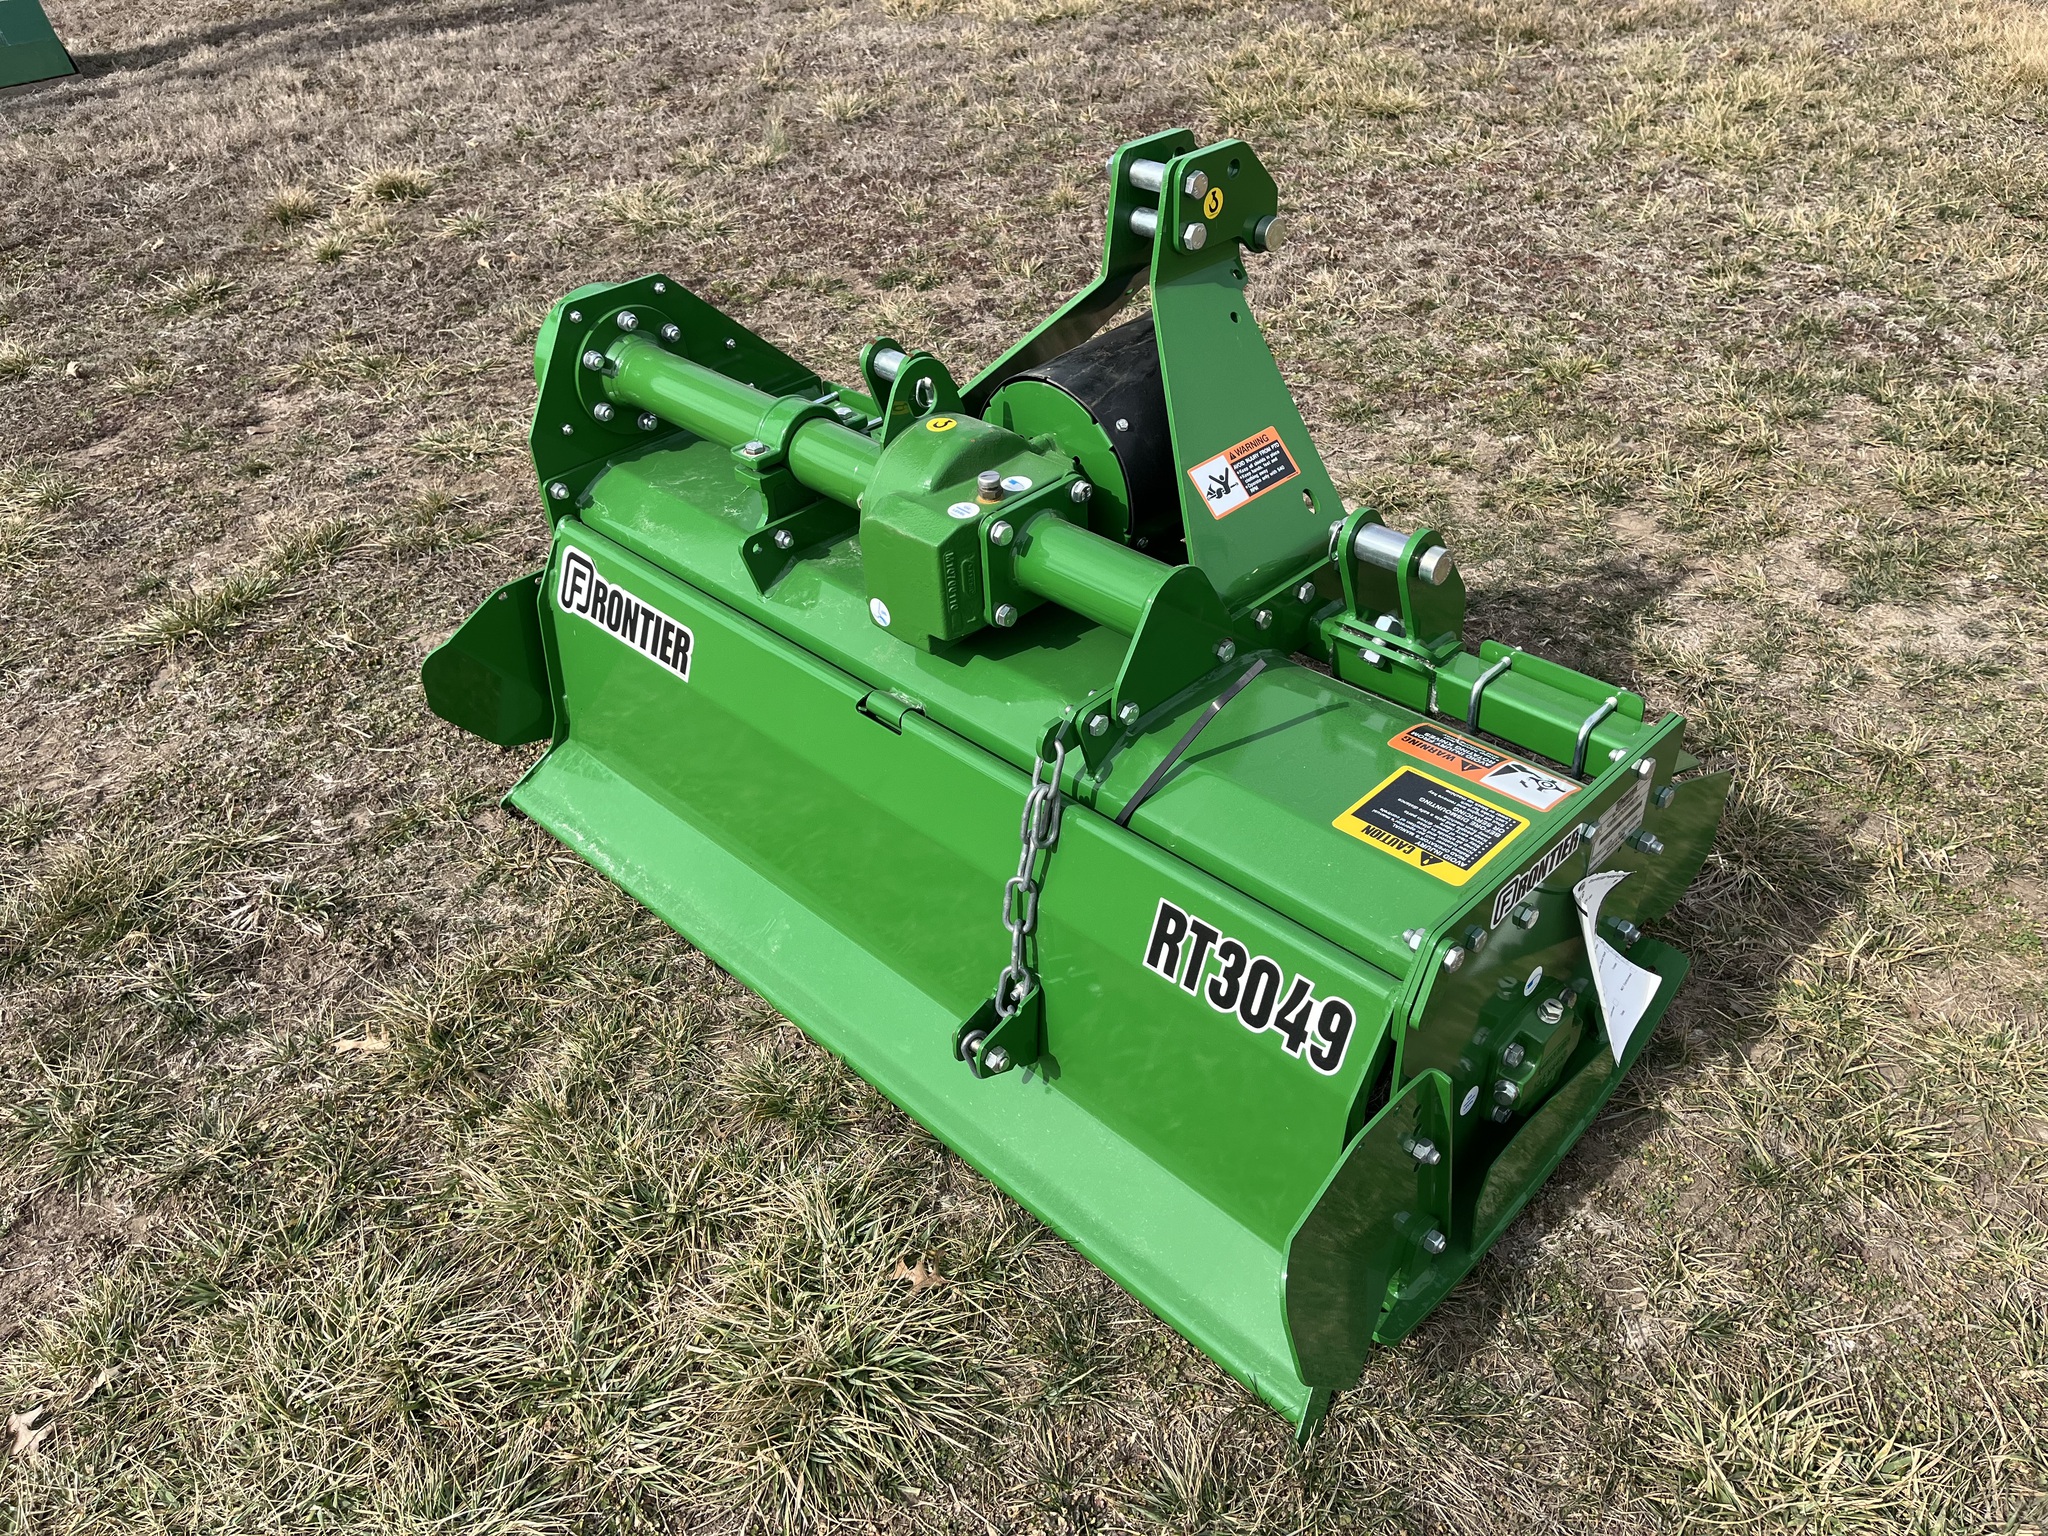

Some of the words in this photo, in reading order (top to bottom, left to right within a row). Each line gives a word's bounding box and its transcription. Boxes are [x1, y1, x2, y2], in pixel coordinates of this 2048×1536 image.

[1234, 434, 1269, 456] WARNING
[1233, 460, 1245, 470] AVOID
[1245, 453, 1259, 463] INJURY
[1259, 446, 1271, 456] FROM
[562, 552, 690, 675] FRONTIER
[1411, 732, 1436, 743] FROM
[1424, 733, 1454, 747] KNIVES
[1401, 735, 1456, 763] WARNING
[1435, 742, 1465, 756] INJURY
[1454, 745, 1496, 764] ROTATING
[1465, 754, 1492, 766] AVOID
[1419, 797, 1470, 823] DISMOUNTING
[1452, 807, 1493, 828] SERVICING
[1390, 823, 1415, 836] MANUAL
[1469, 821, 1501, 838] BEFORE
[1361, 825, 1416, 854] CAUTION
[1414, 841, 1443, 856] INJURY
[1443, 854, 1468, 867] AVOID
[1450, 852, 1467, 861] READ
[1492, 827, 1580, 926] FRONTIER
[1146, 902, 1352, 1071] RT3049
